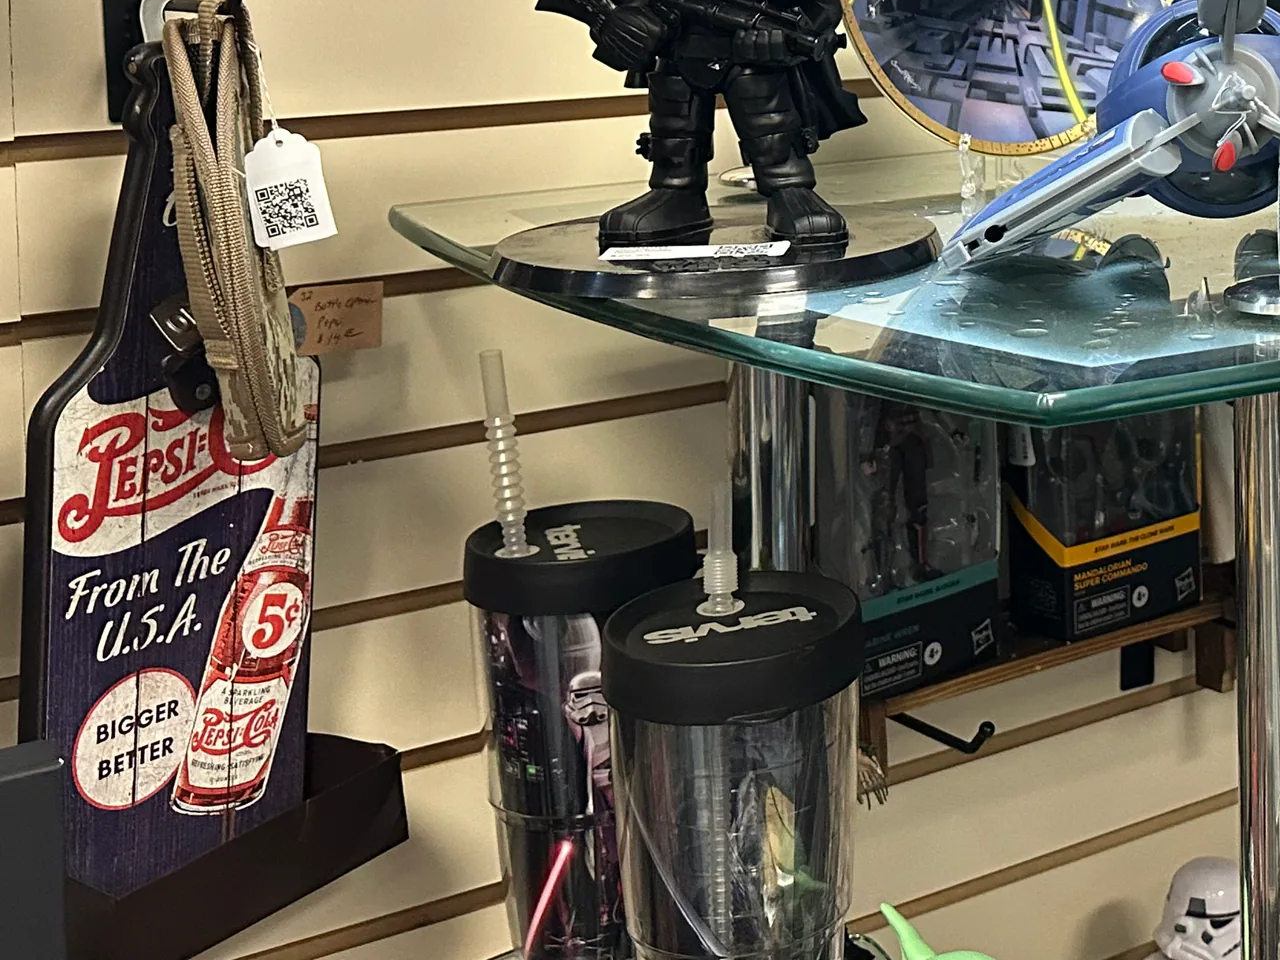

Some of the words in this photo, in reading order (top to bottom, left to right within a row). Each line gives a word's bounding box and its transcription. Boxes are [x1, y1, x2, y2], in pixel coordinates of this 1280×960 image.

[65, 568, 158, 620] From
[175, 538, 231, 587] The
[1073, 558, 1132, 583] MANDALORIAN
[1073, 576, 1101, 591] SUPER
[1101, 562, 1148, 583] COMMANDO
[96, 593, 202, 662] U.S.A.
[643, 606, 818, 645] tervis
[224, 695, 264, 706] BEVERAGE
[229, 685, 271, 696] SPARKLING
[96, 699, 179, 745] BIGGER
[98, 736, 174, 781] BETTER
